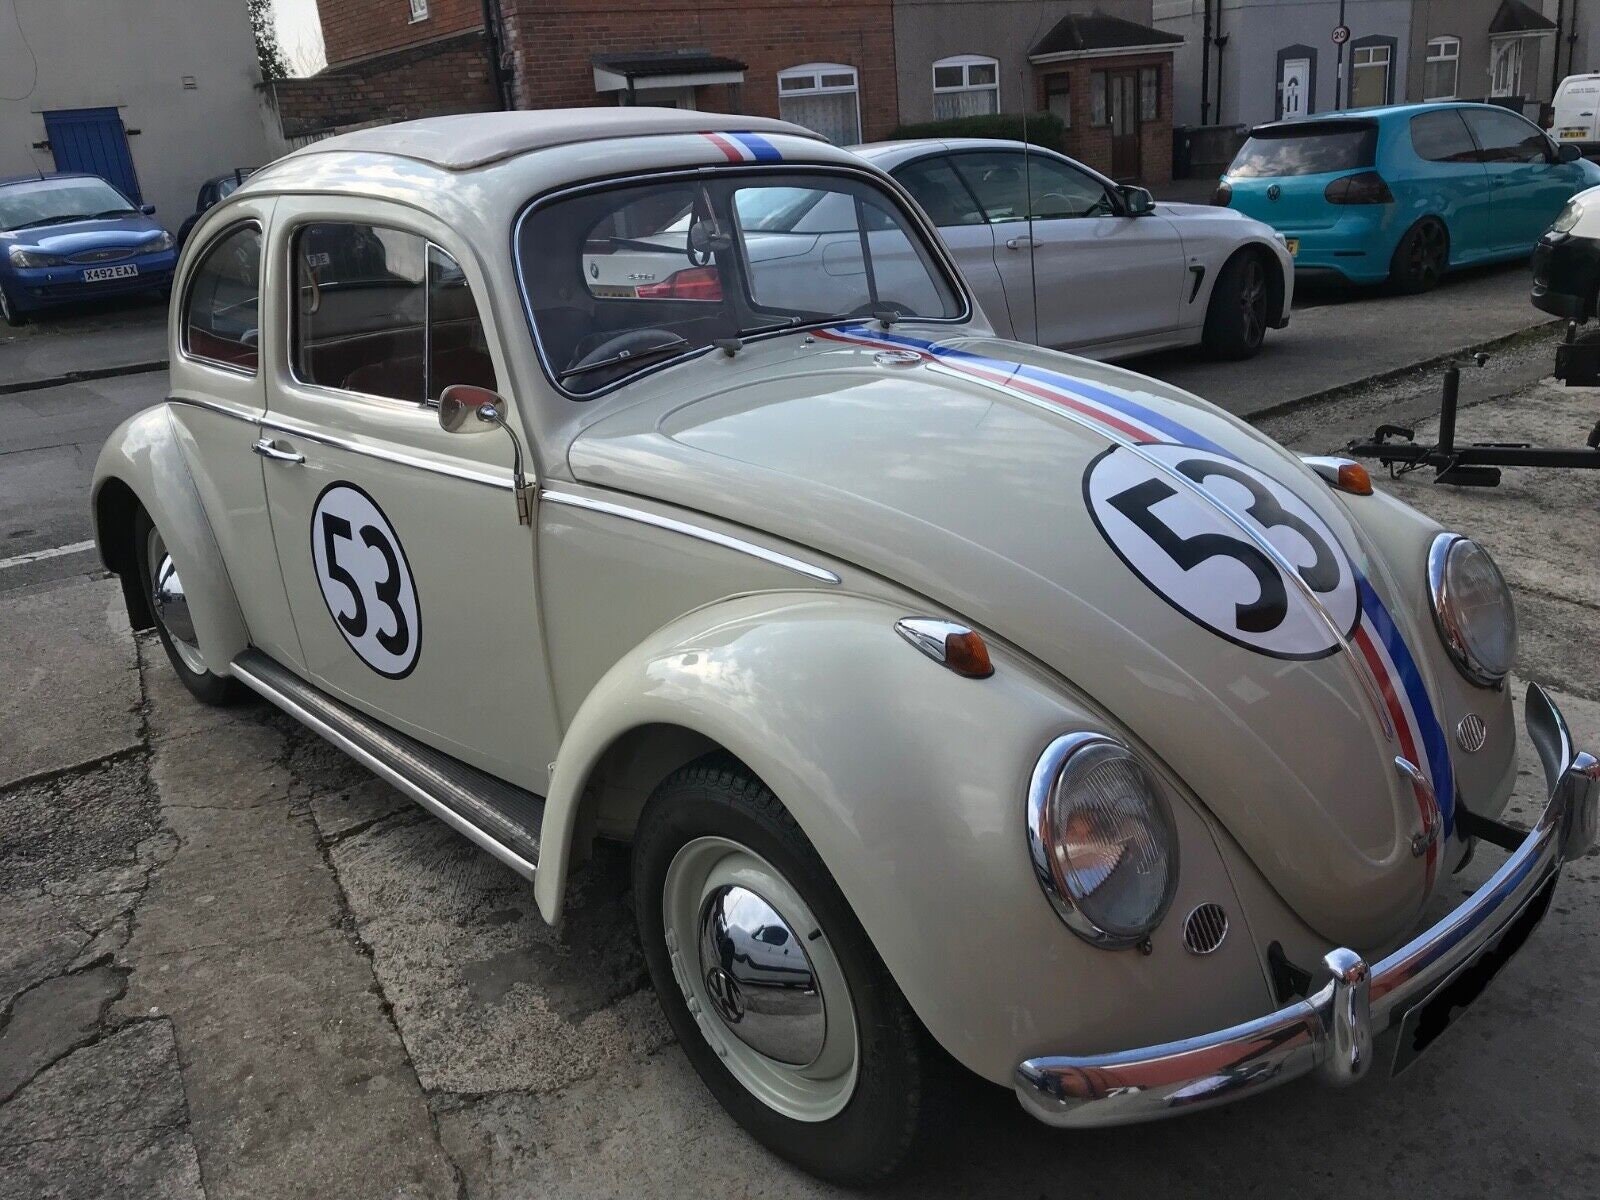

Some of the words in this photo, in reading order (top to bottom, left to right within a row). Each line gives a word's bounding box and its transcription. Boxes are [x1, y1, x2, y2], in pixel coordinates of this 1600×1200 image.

[1334, 30, 1345, 40] 20
[86, 268, 114, 280] X492
[115, 264, 137, 276] EAX
[321, 511, 409, 656] 53
[1105, 458, 1341, 633] 53
